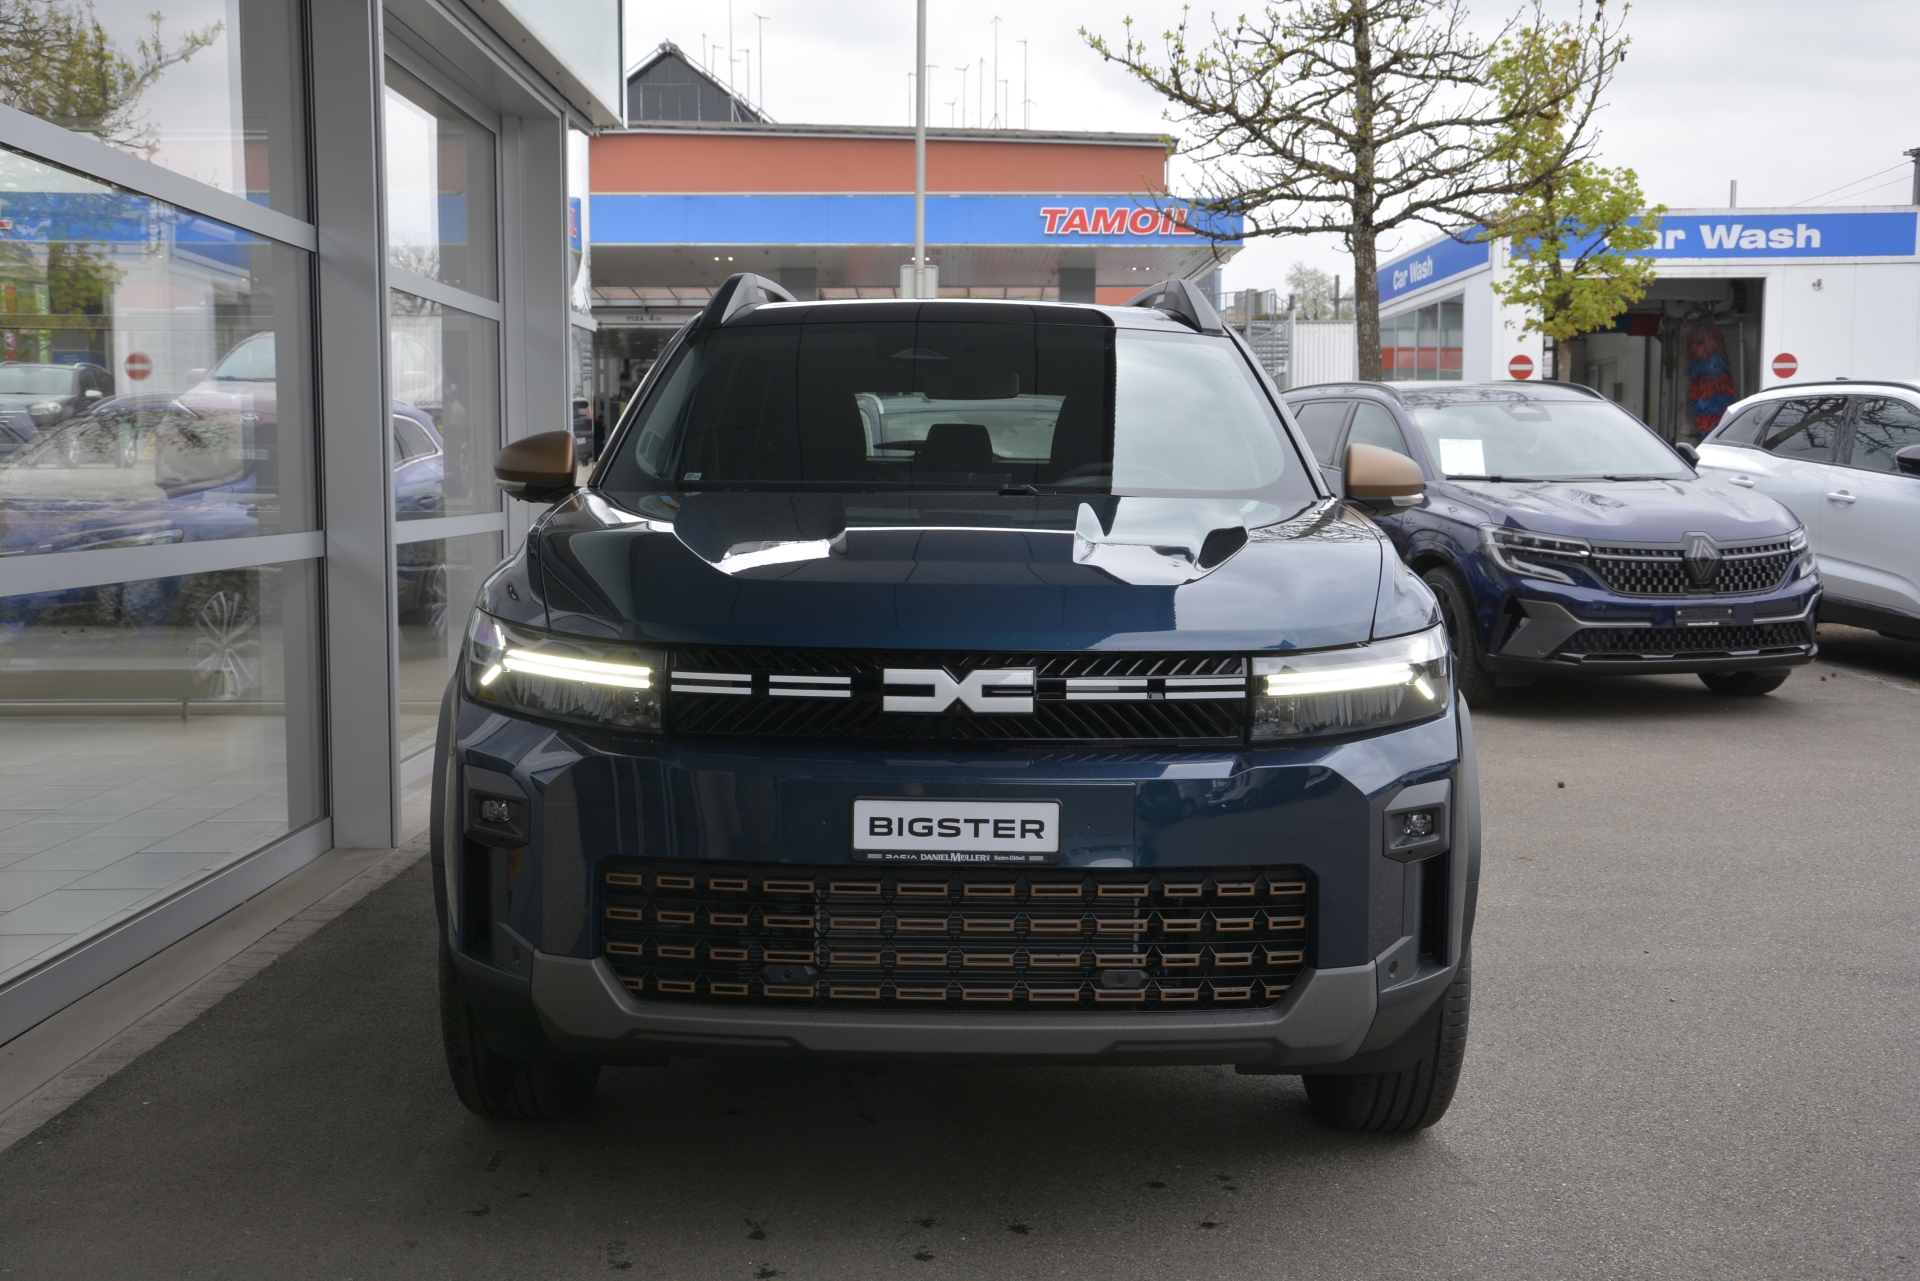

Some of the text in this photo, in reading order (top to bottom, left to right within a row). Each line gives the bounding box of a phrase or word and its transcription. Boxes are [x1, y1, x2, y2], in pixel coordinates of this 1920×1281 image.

[1040, 207, 1196, 236] TAMOIL
[1699, 223, 1821, 249] Wash
[1393, 255, 1433, 291] Car Wash
[869, 816, 1045, 839] BIGSTER
